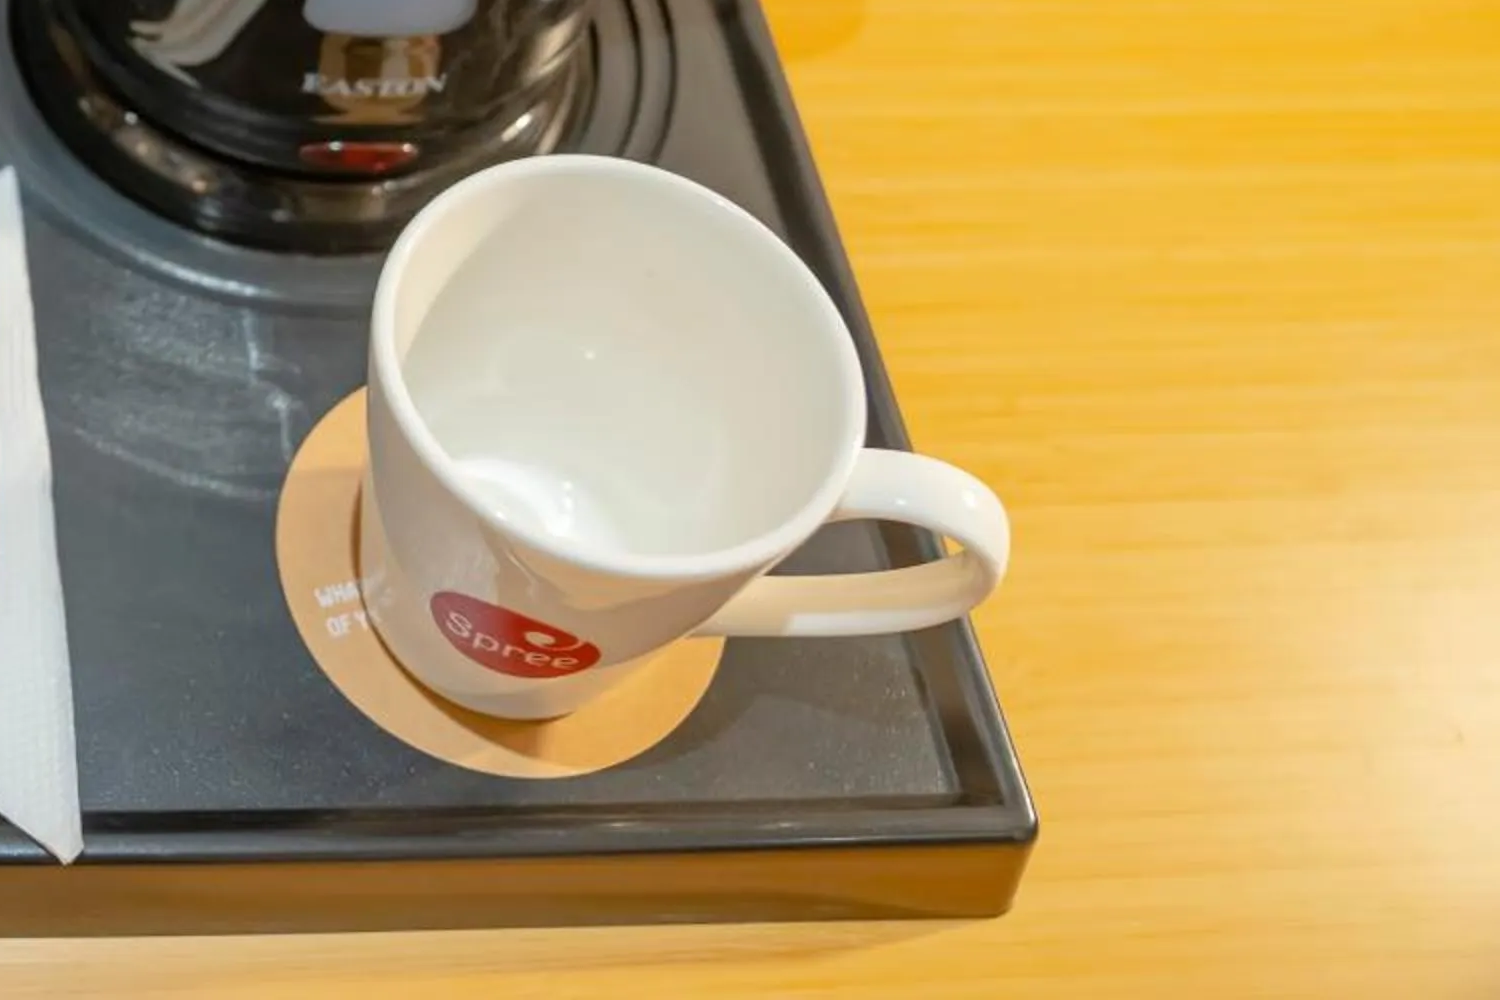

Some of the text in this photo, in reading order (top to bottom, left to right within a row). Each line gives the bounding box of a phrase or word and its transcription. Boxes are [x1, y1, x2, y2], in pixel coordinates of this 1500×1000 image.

[301, 73, 447, 97] EASTON
[313, 580, 361, 608] WHA
[444, 609, 581, 670] Spree
